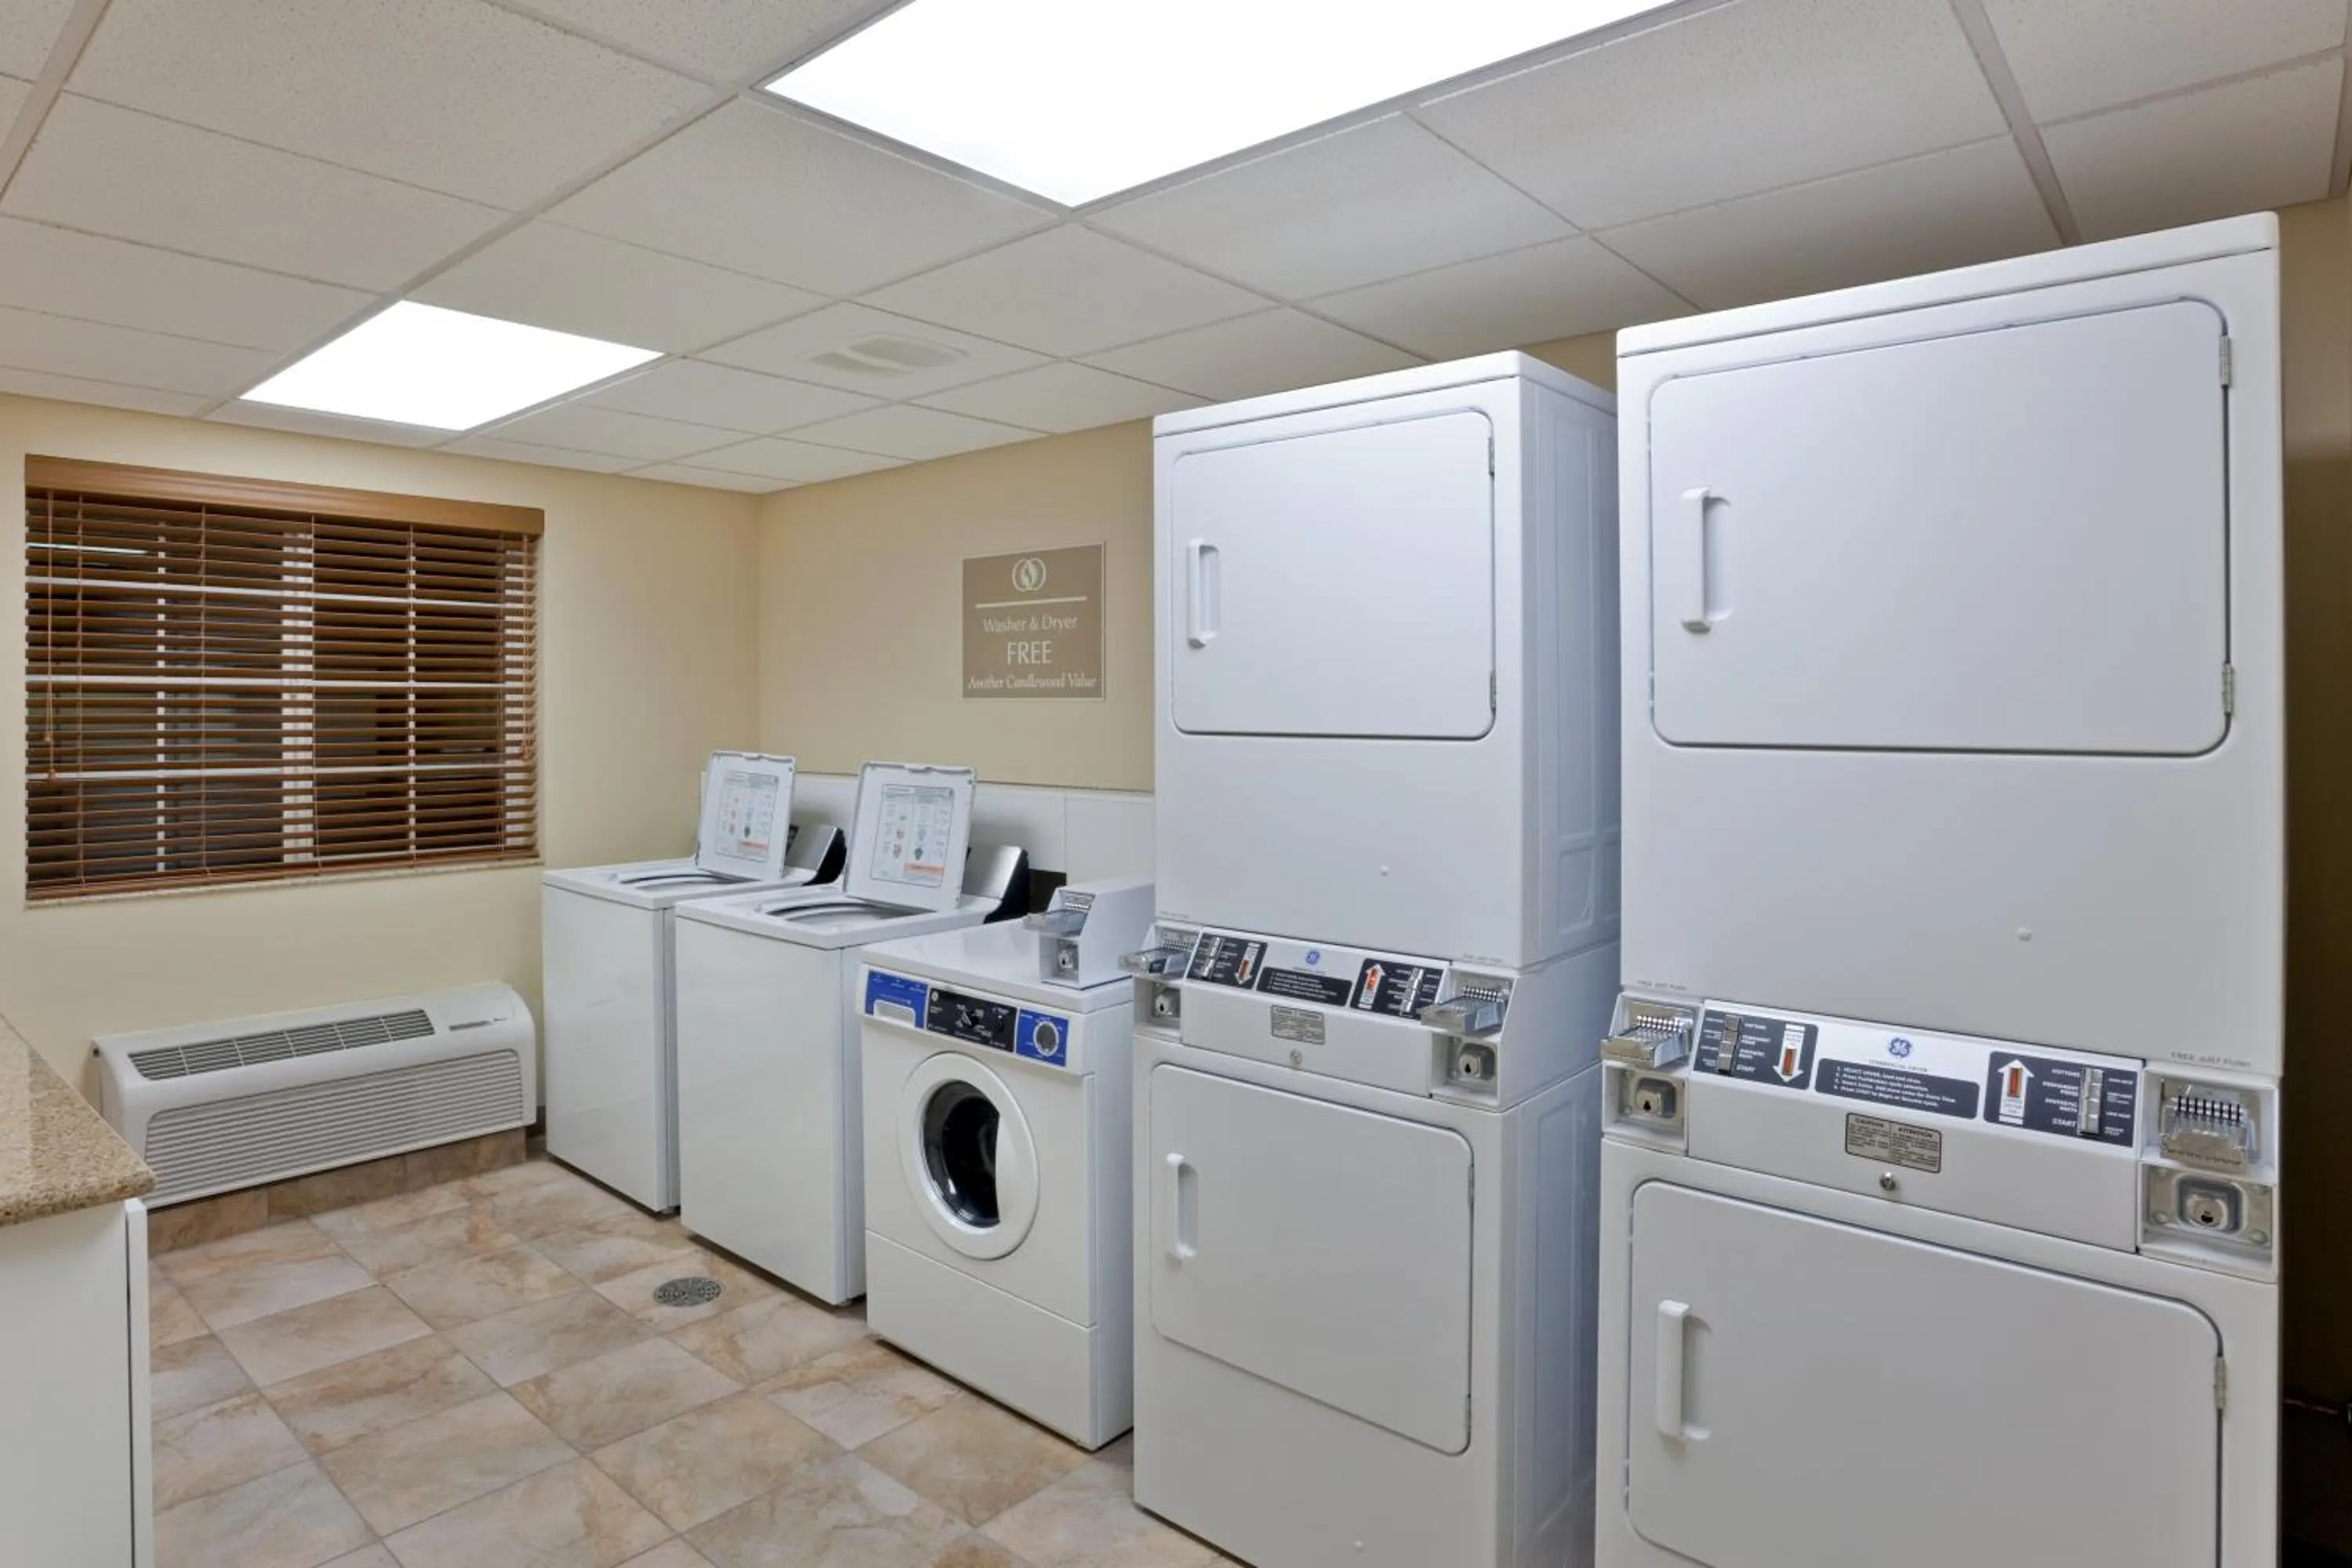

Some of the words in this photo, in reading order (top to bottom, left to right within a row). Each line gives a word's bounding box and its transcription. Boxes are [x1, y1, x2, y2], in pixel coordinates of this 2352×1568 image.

[983, 617, 1026, 633] Washer
[1029, 616, 1040, 630] &
[1042, 615, 1077, 633] Dryer
[1007, 640, 1052, 666] FREE
[968, 674, 1004, 690] Another
[1067, 671, 1096, 690] Value
